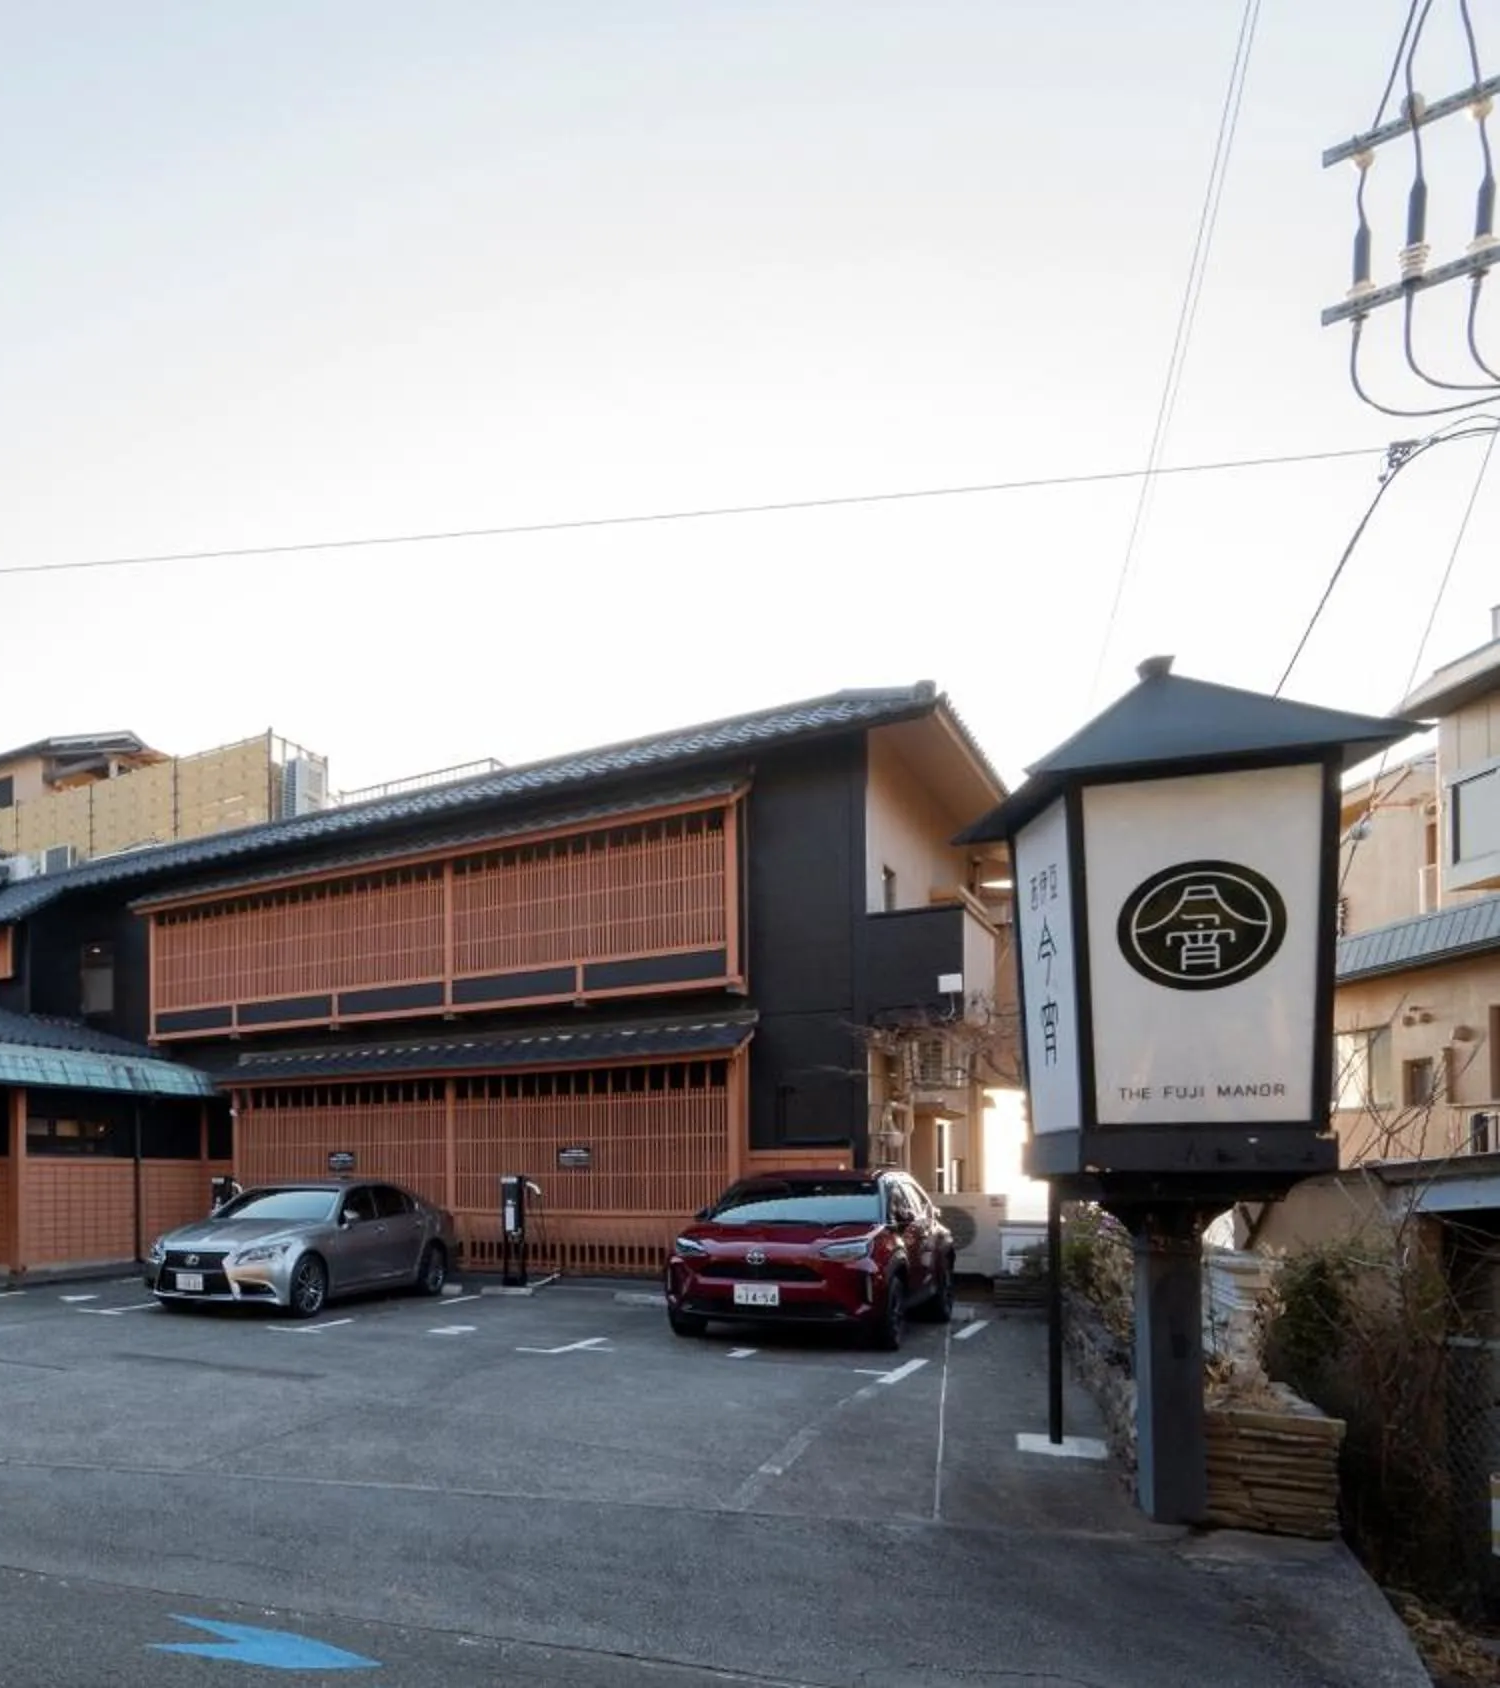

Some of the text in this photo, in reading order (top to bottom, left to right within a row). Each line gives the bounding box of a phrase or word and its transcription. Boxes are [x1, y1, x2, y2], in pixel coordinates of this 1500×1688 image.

[1037, 915, 1059, 1066] 今宵
[1119, 1083, 1286, 1100] THE FUJI MANOR
